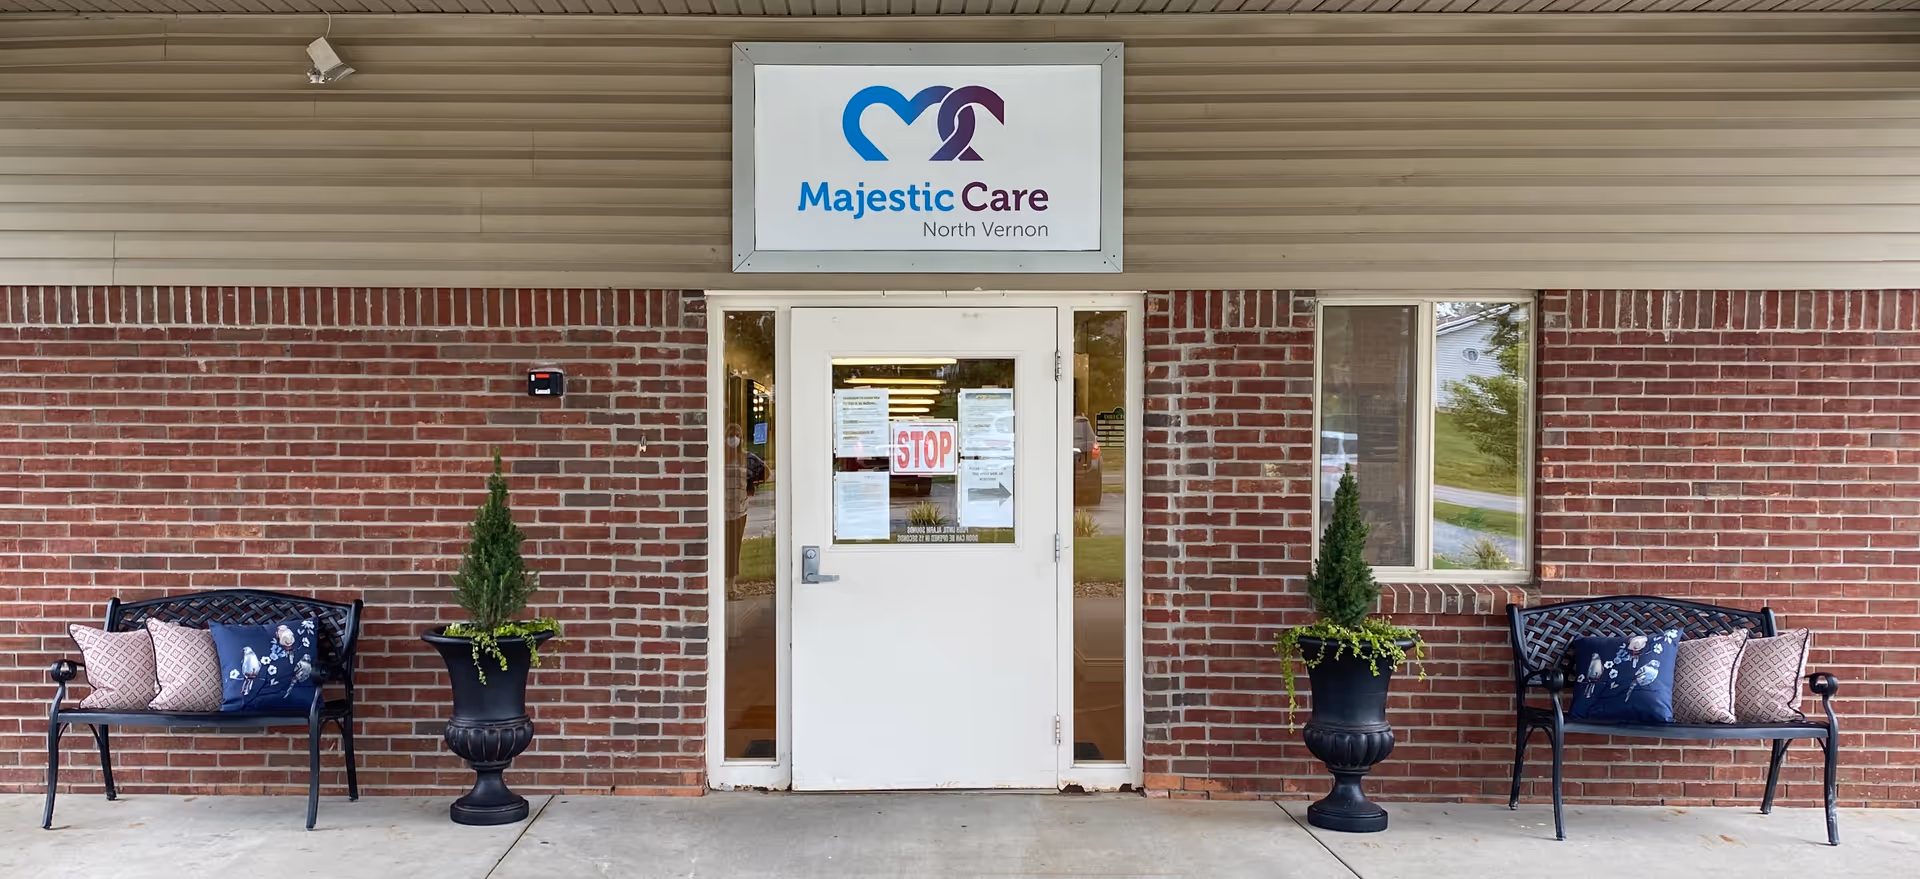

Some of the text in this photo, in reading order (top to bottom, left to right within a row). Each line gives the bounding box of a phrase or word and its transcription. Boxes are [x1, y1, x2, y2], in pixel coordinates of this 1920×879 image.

[797, 181, 1049, 219] Majestic Care
[923, 221, 1049, 237] North Vernon
[897, 430, 952, 469] STOP
